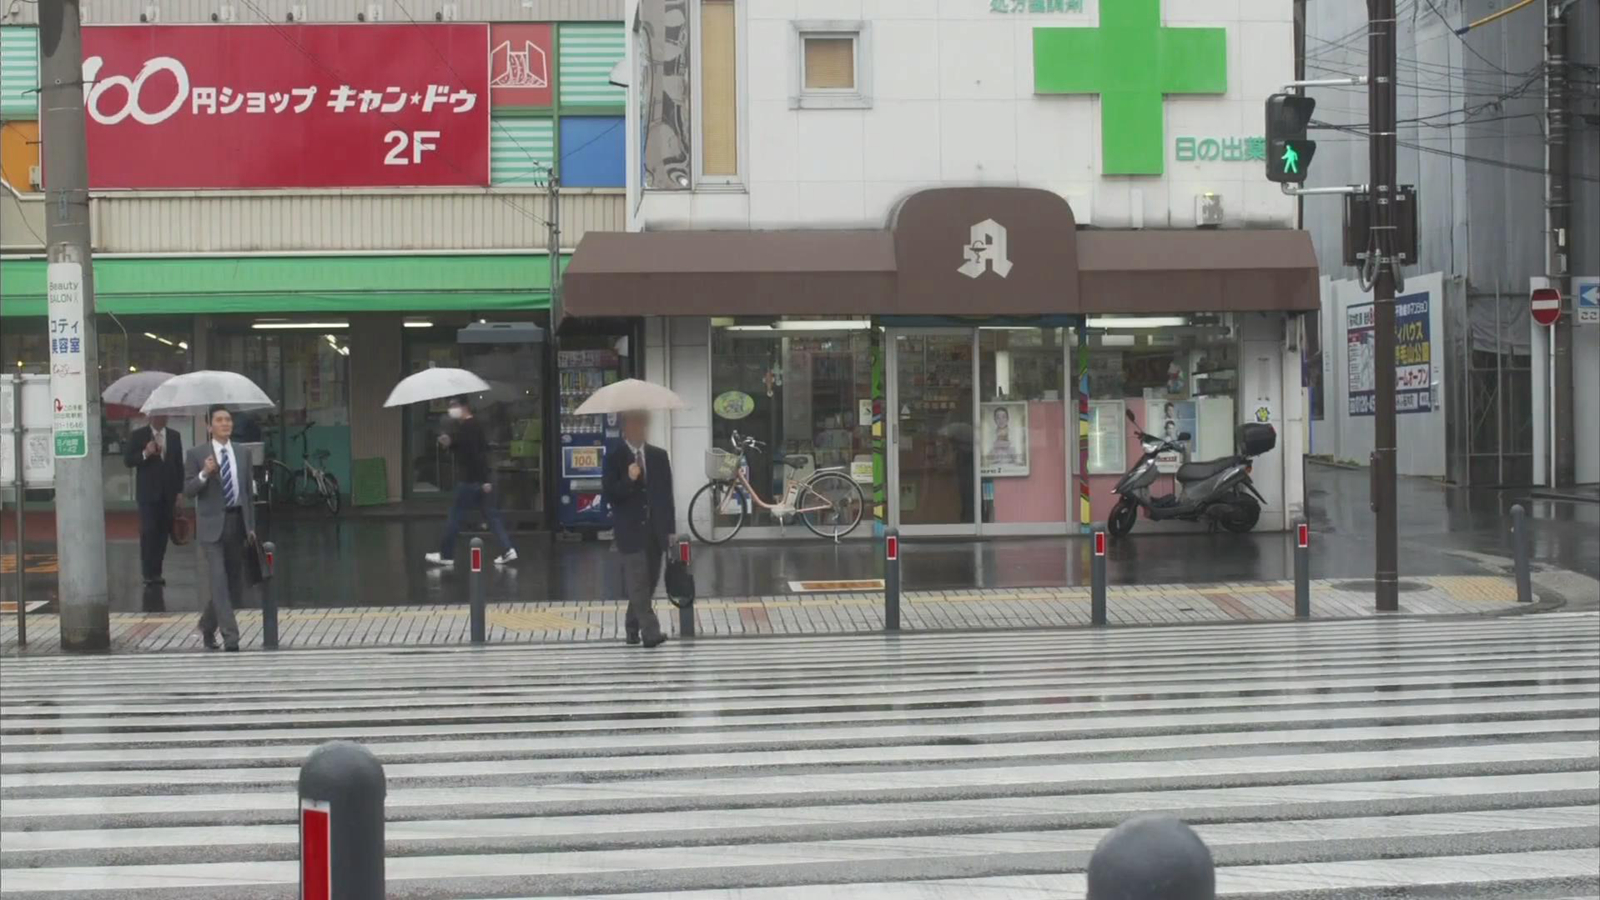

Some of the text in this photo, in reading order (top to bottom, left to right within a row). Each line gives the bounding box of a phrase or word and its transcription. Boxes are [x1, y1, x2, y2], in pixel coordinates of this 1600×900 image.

[383, 129, 441, 166] 2F
[52, 338, 80, 354] 美容室
